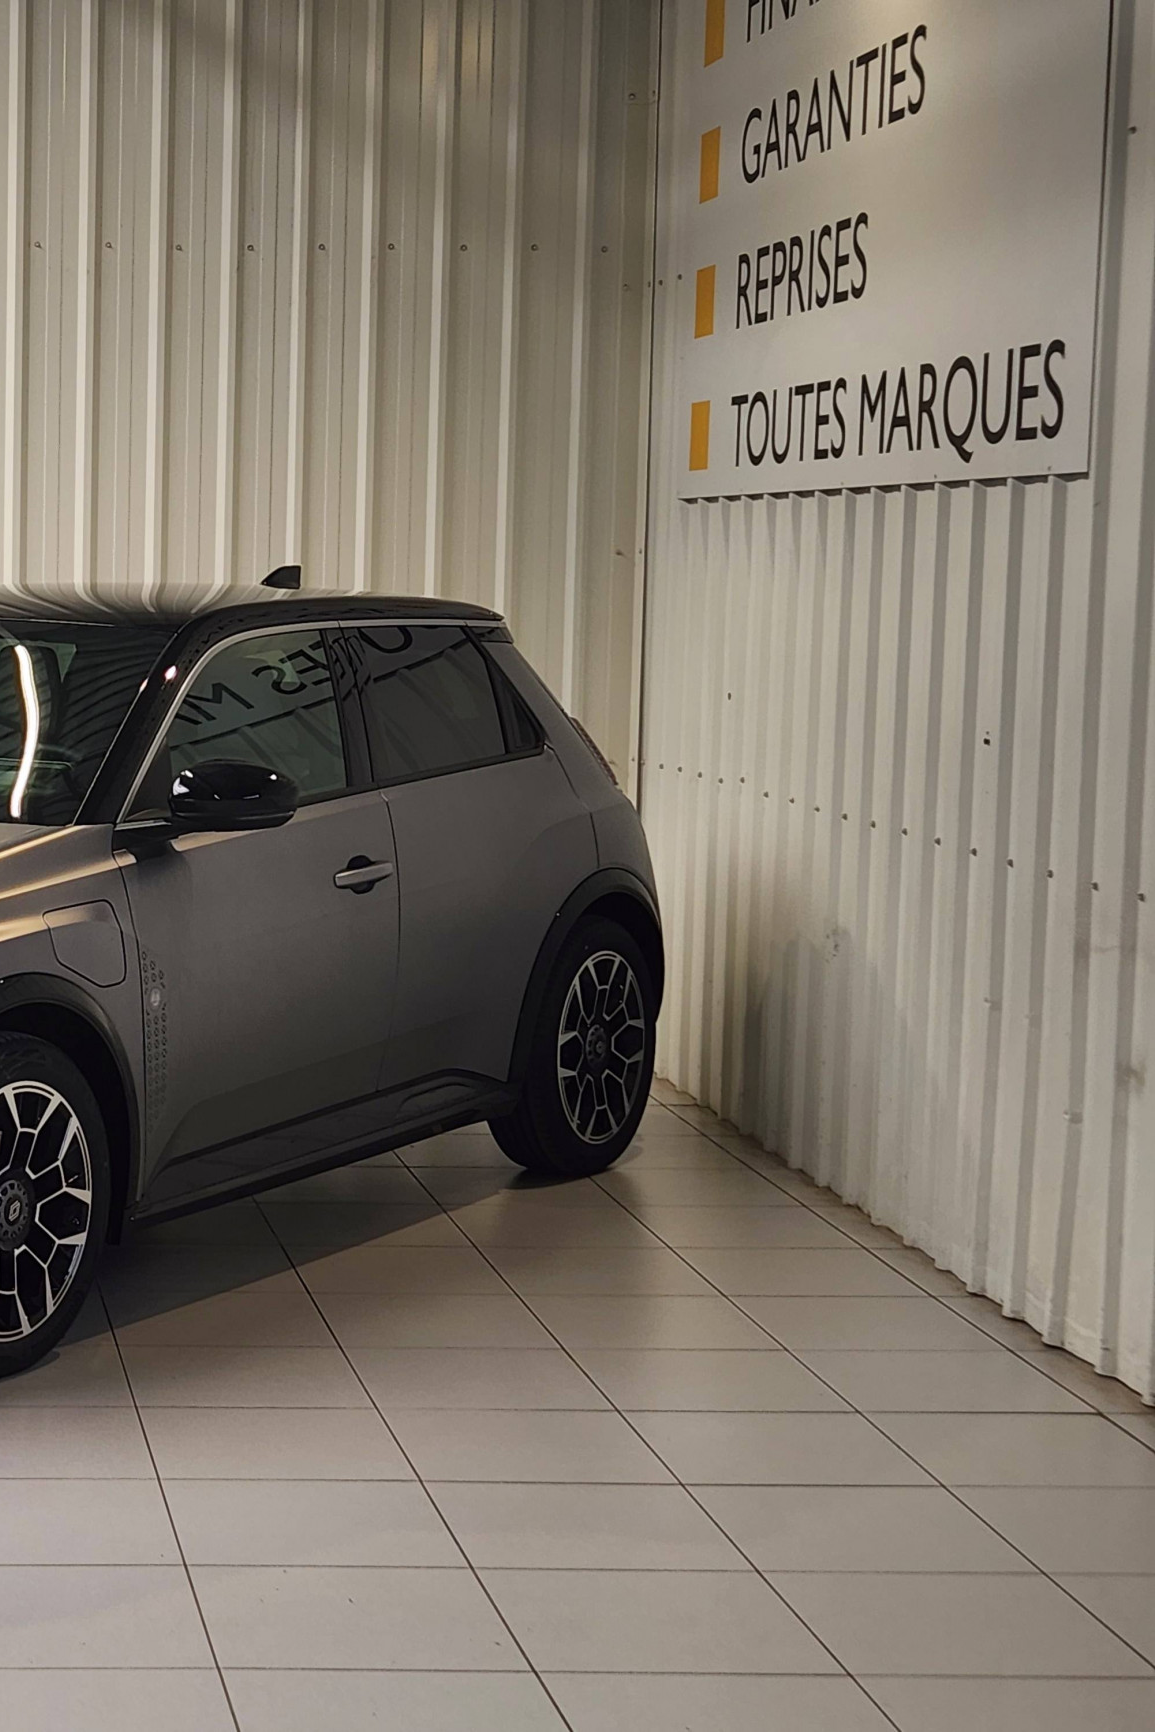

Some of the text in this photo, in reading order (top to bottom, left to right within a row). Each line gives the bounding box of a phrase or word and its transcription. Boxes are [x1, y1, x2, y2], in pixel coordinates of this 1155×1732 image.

[741, 24, 927, 184] GARANTIES
[736, 212, 869, 330] REPRISES
[731, 339, 1066, 467] TOUTES MARQUES
